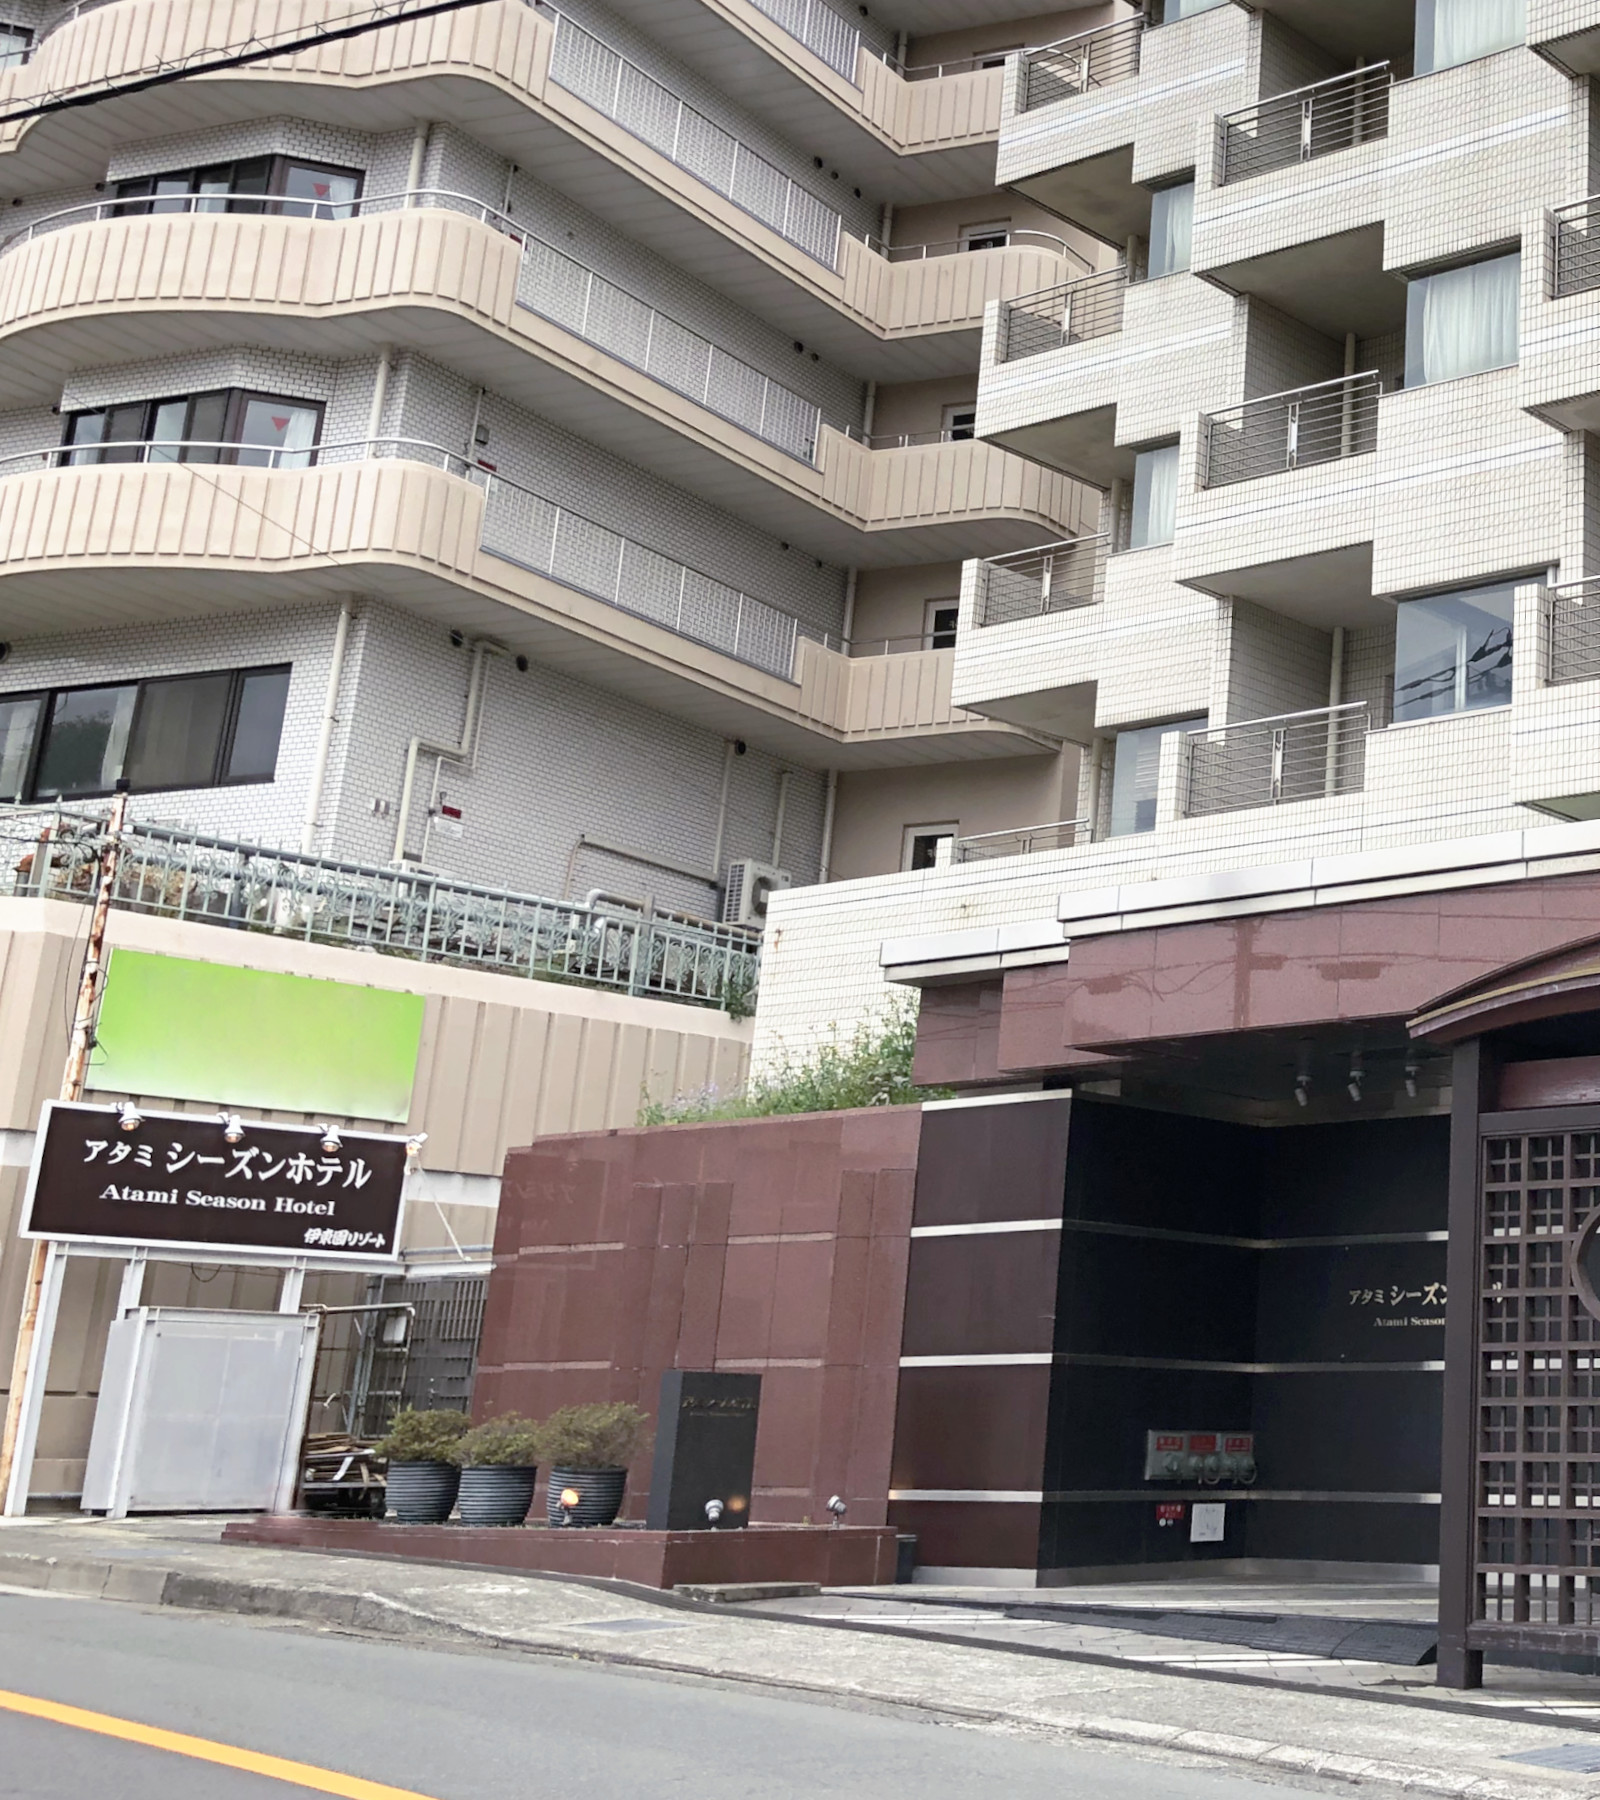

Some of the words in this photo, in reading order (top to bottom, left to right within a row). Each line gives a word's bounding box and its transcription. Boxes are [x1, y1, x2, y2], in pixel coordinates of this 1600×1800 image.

[99, 1184, 179, 1204] Atami
[185, 1190, 267, 1211] Season
[273, 1197, 336, 1216] Hotel
